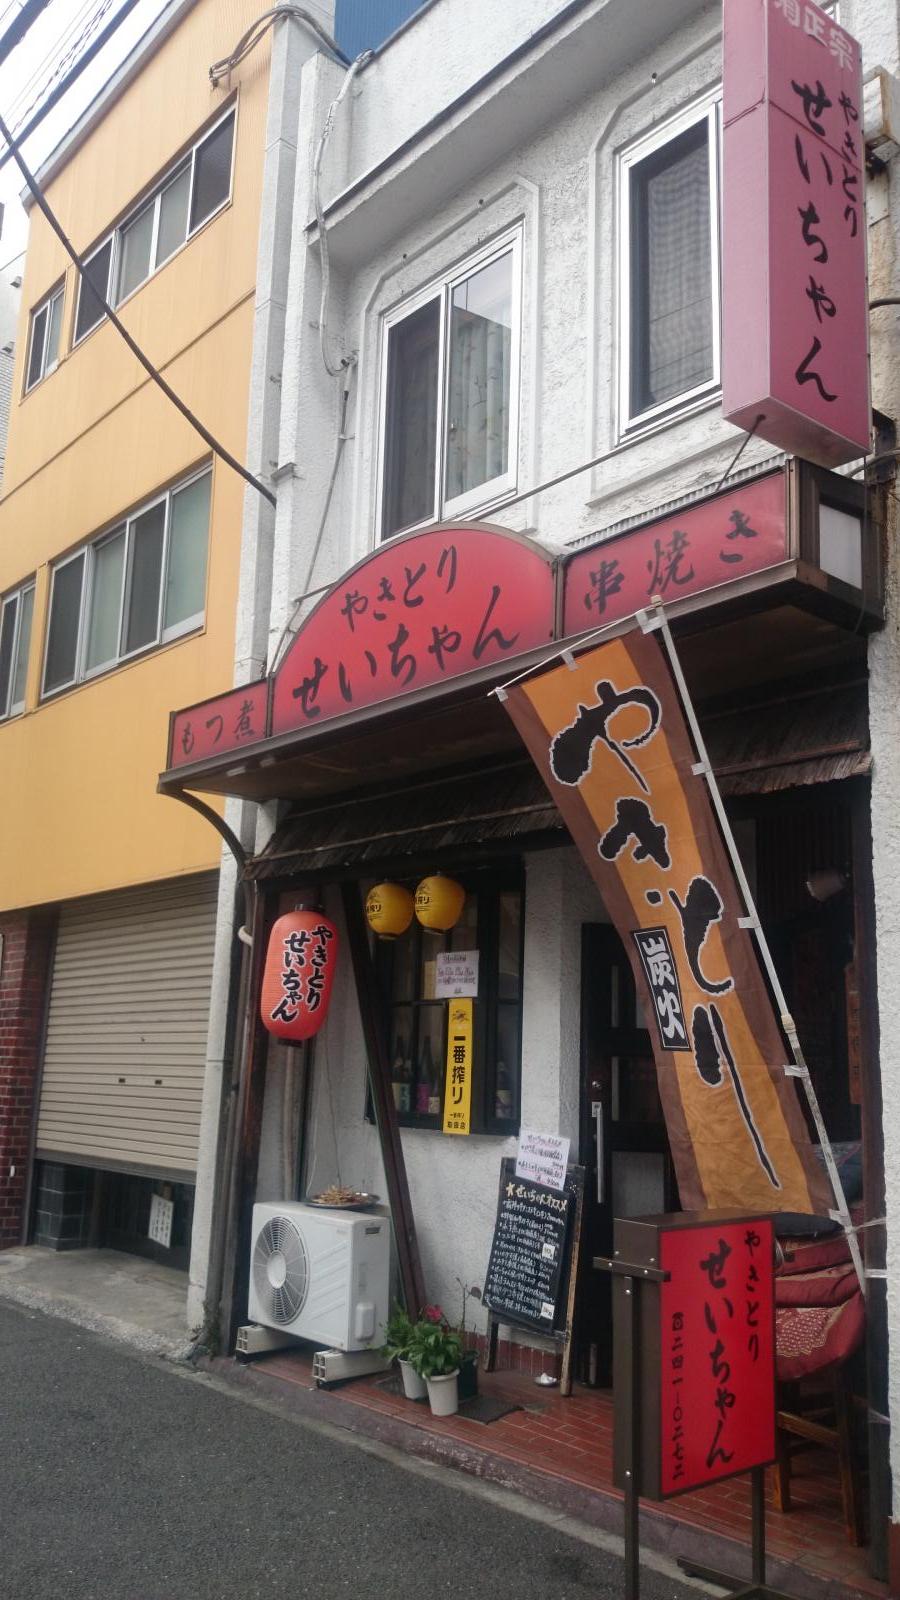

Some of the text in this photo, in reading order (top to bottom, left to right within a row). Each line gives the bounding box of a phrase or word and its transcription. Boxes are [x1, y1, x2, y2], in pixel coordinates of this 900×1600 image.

[837, 90, 858, 238] やきとり
[790, 79, 839, 402] せいちゃん
[341, 545, 458, 632] やきとり
[583, 510, 758, 615] 串焼き
[292, 585, 520, 719] せいちゃん
[180, 700, 256, 756] もつ煮
[271, 930, 312, 1023] せいちゃん
[306, 924, 333, 1012] やきとり
[550, 679, 783, 1192] やきとり
[700, 1238, 737, 1469] せいちゃん
[744, 1230, 761, 1361] やきとり
